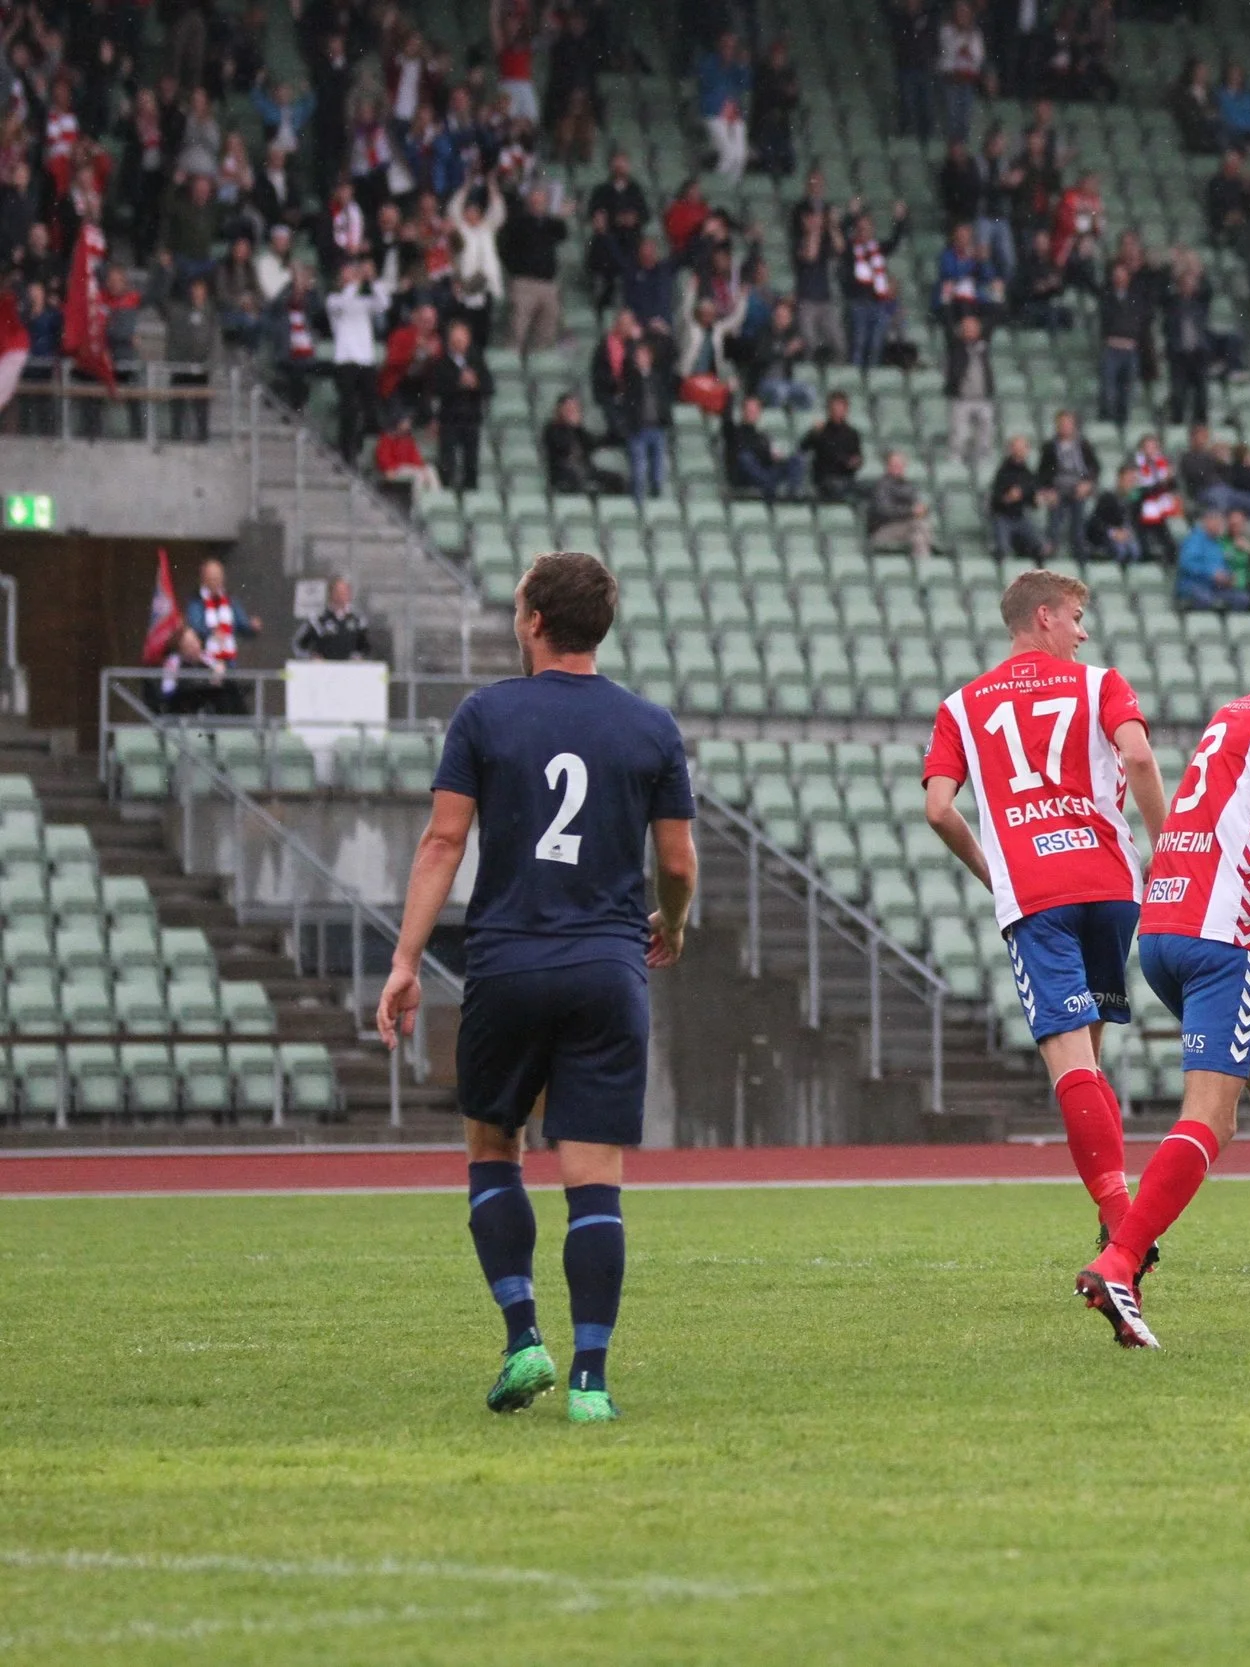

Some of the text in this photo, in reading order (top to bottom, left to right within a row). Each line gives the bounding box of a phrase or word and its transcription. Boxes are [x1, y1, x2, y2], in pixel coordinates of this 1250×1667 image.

[975, 675, 1077, 698] PRIVATMEGLEREN
[983, 697, 1078, 794] 17
[1175, 722, 1227, 814] 3
[535, 752, 588, 865] 2
[1155, 831, 1214, 853] NYHEIM
